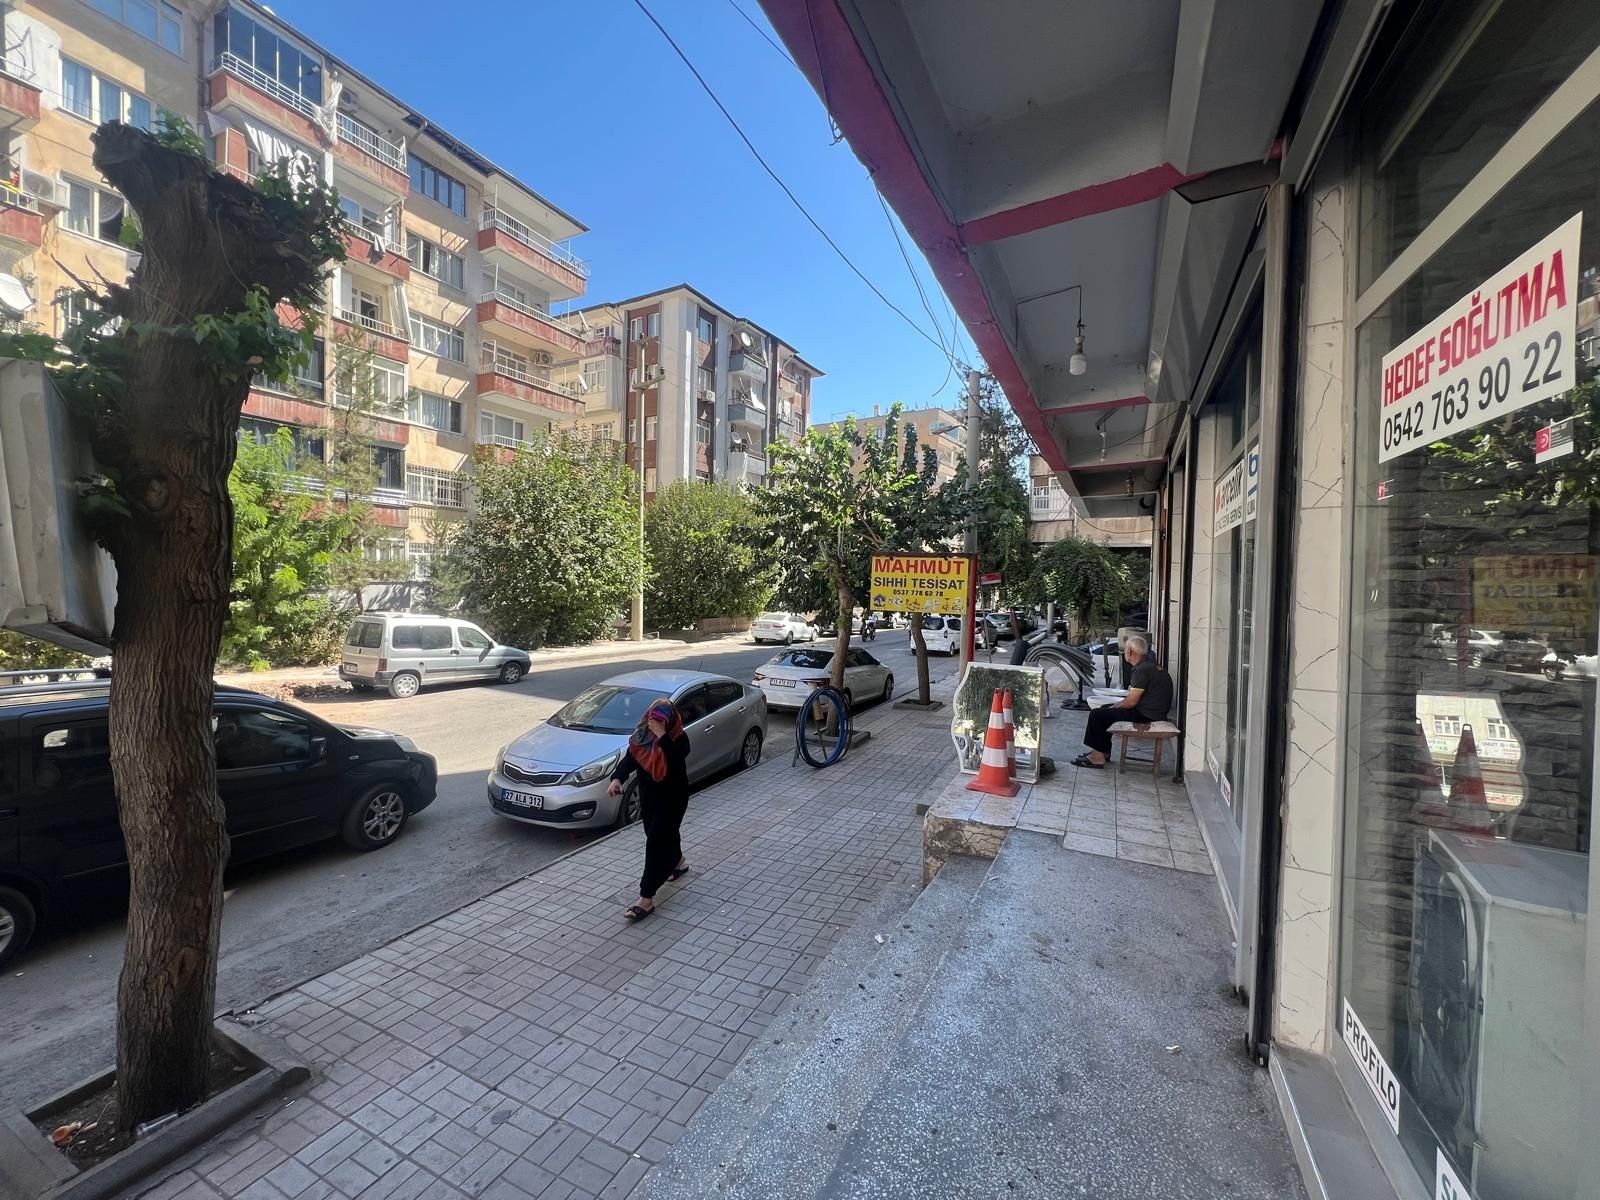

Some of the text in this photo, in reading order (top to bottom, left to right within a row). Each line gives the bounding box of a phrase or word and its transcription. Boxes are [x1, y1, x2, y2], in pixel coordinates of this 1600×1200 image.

[1383, 248, 1567, 408] HEDEF SOĞUTMA
[1383, 330, 1562, 451] 0542 763 90 22
[874, 558, 965, 575] MAHMUT
[911, 576, 965, 590] TESİSAT
[505, 791, 542, 807] 27 ALA 312
